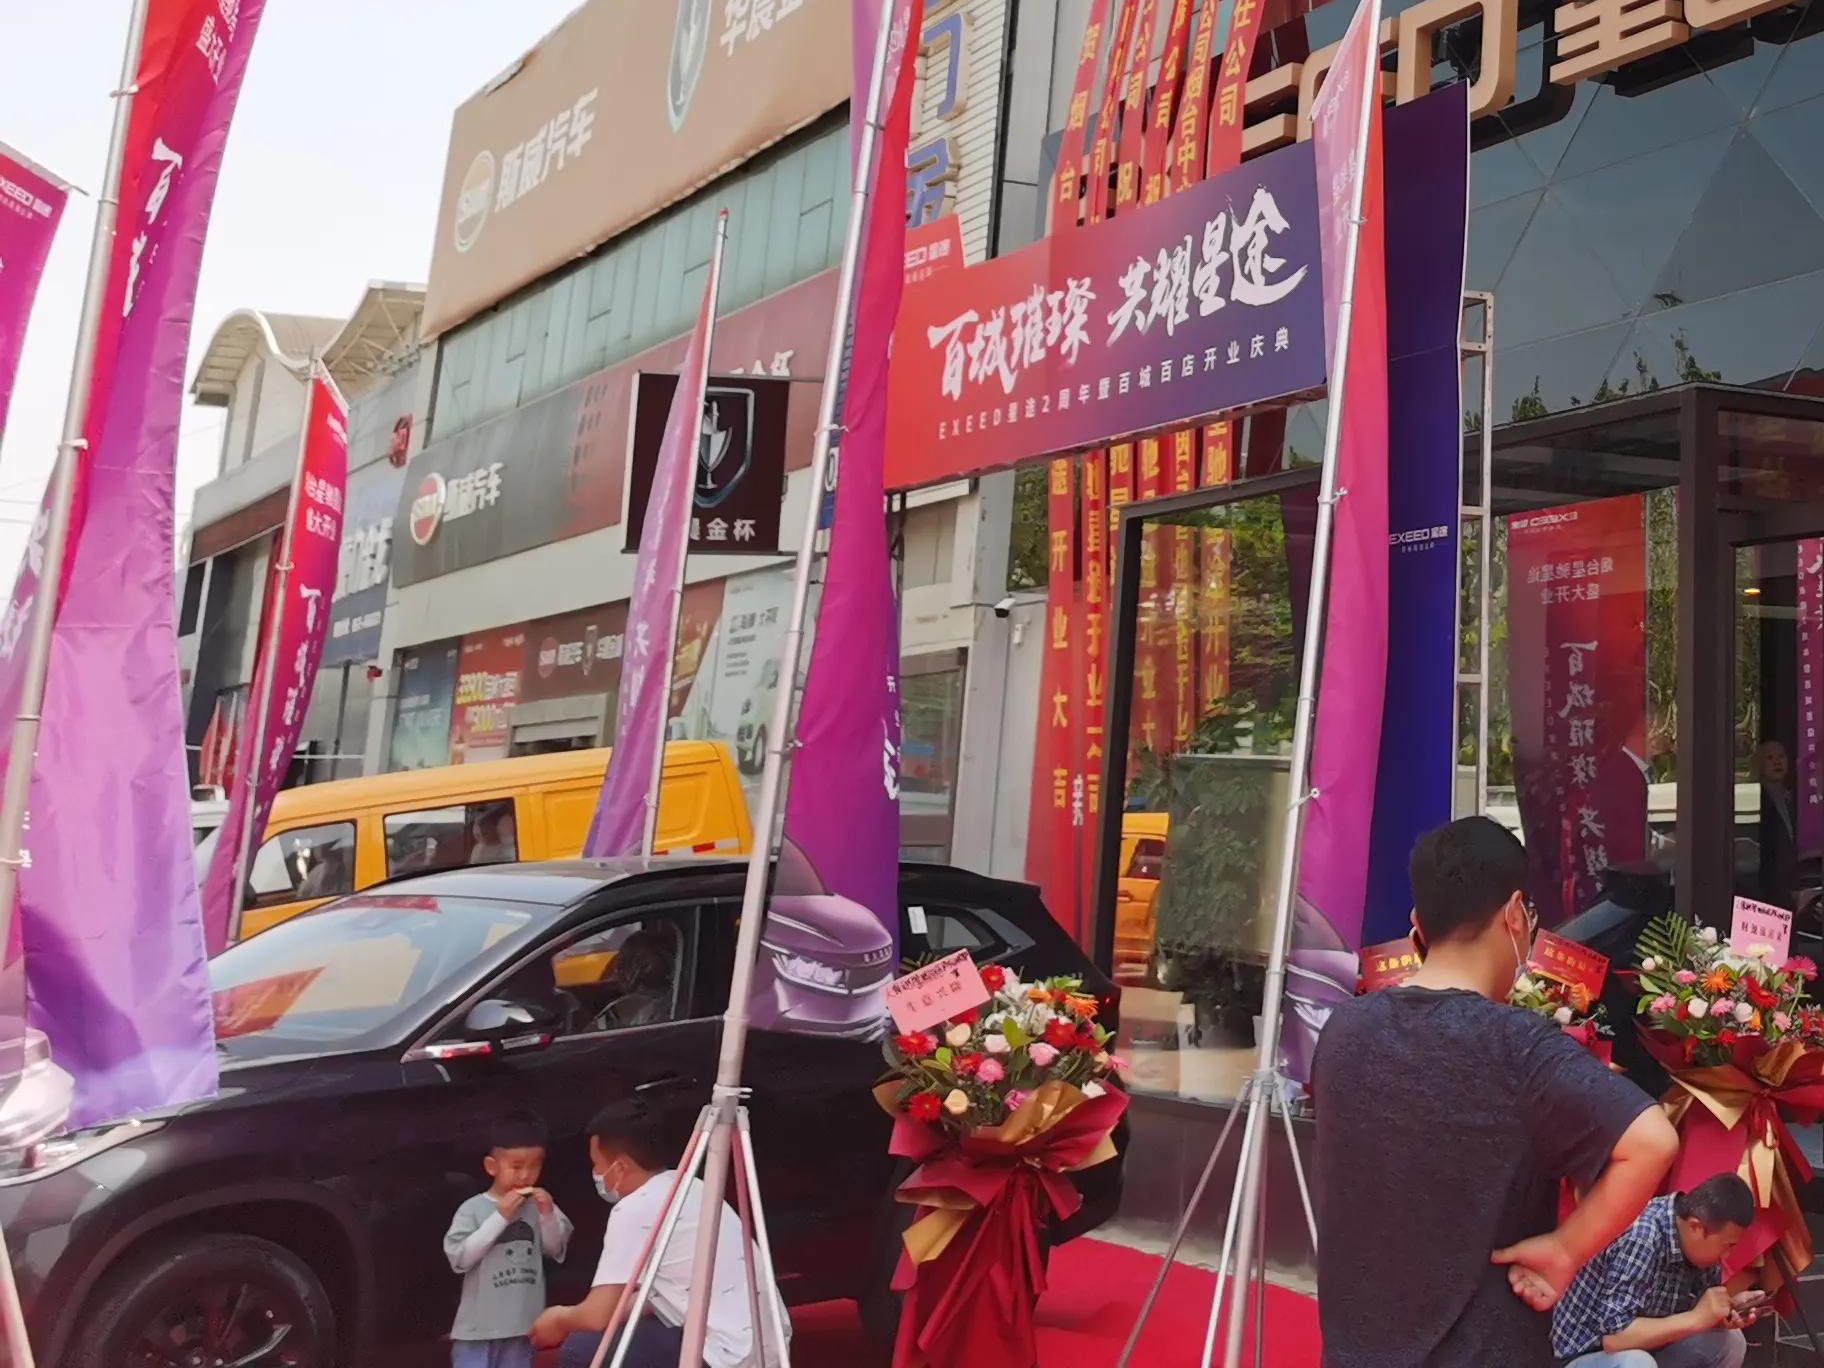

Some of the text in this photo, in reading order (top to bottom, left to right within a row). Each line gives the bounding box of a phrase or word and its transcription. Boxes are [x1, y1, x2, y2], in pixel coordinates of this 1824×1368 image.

[926, 277, 1097, 401] 百城璀璨
[1106, 184, 1308, 347] 共耀星途
